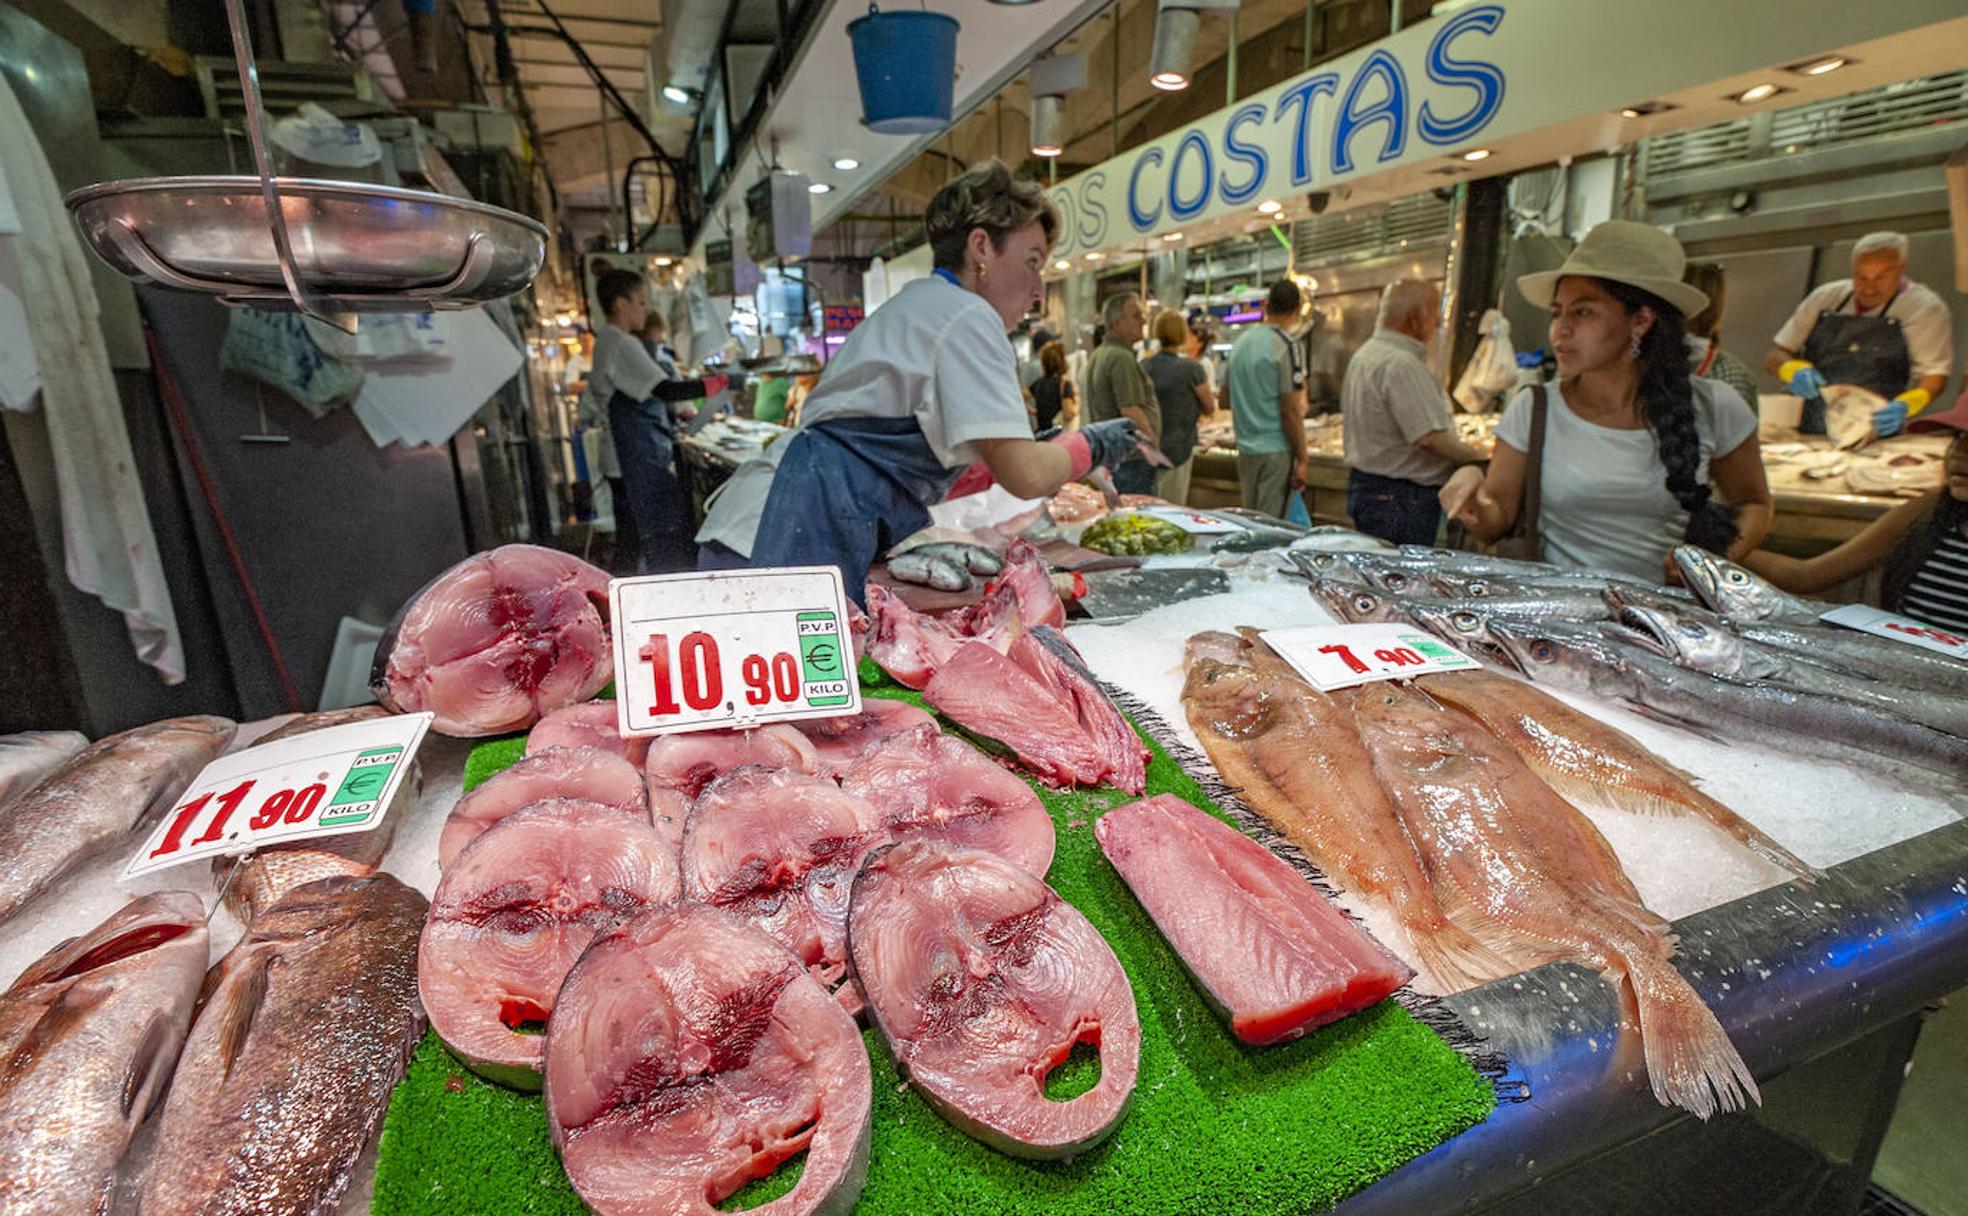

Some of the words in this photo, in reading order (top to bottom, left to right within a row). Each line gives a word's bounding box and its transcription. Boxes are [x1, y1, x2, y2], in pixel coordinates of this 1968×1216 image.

[1127, 5, 1506, 232] COSTAS
[800, 622, 836, 632] P.V.P.
[810, 684, 843, 694] KILO
[328, 803, 370, 815] KILO
